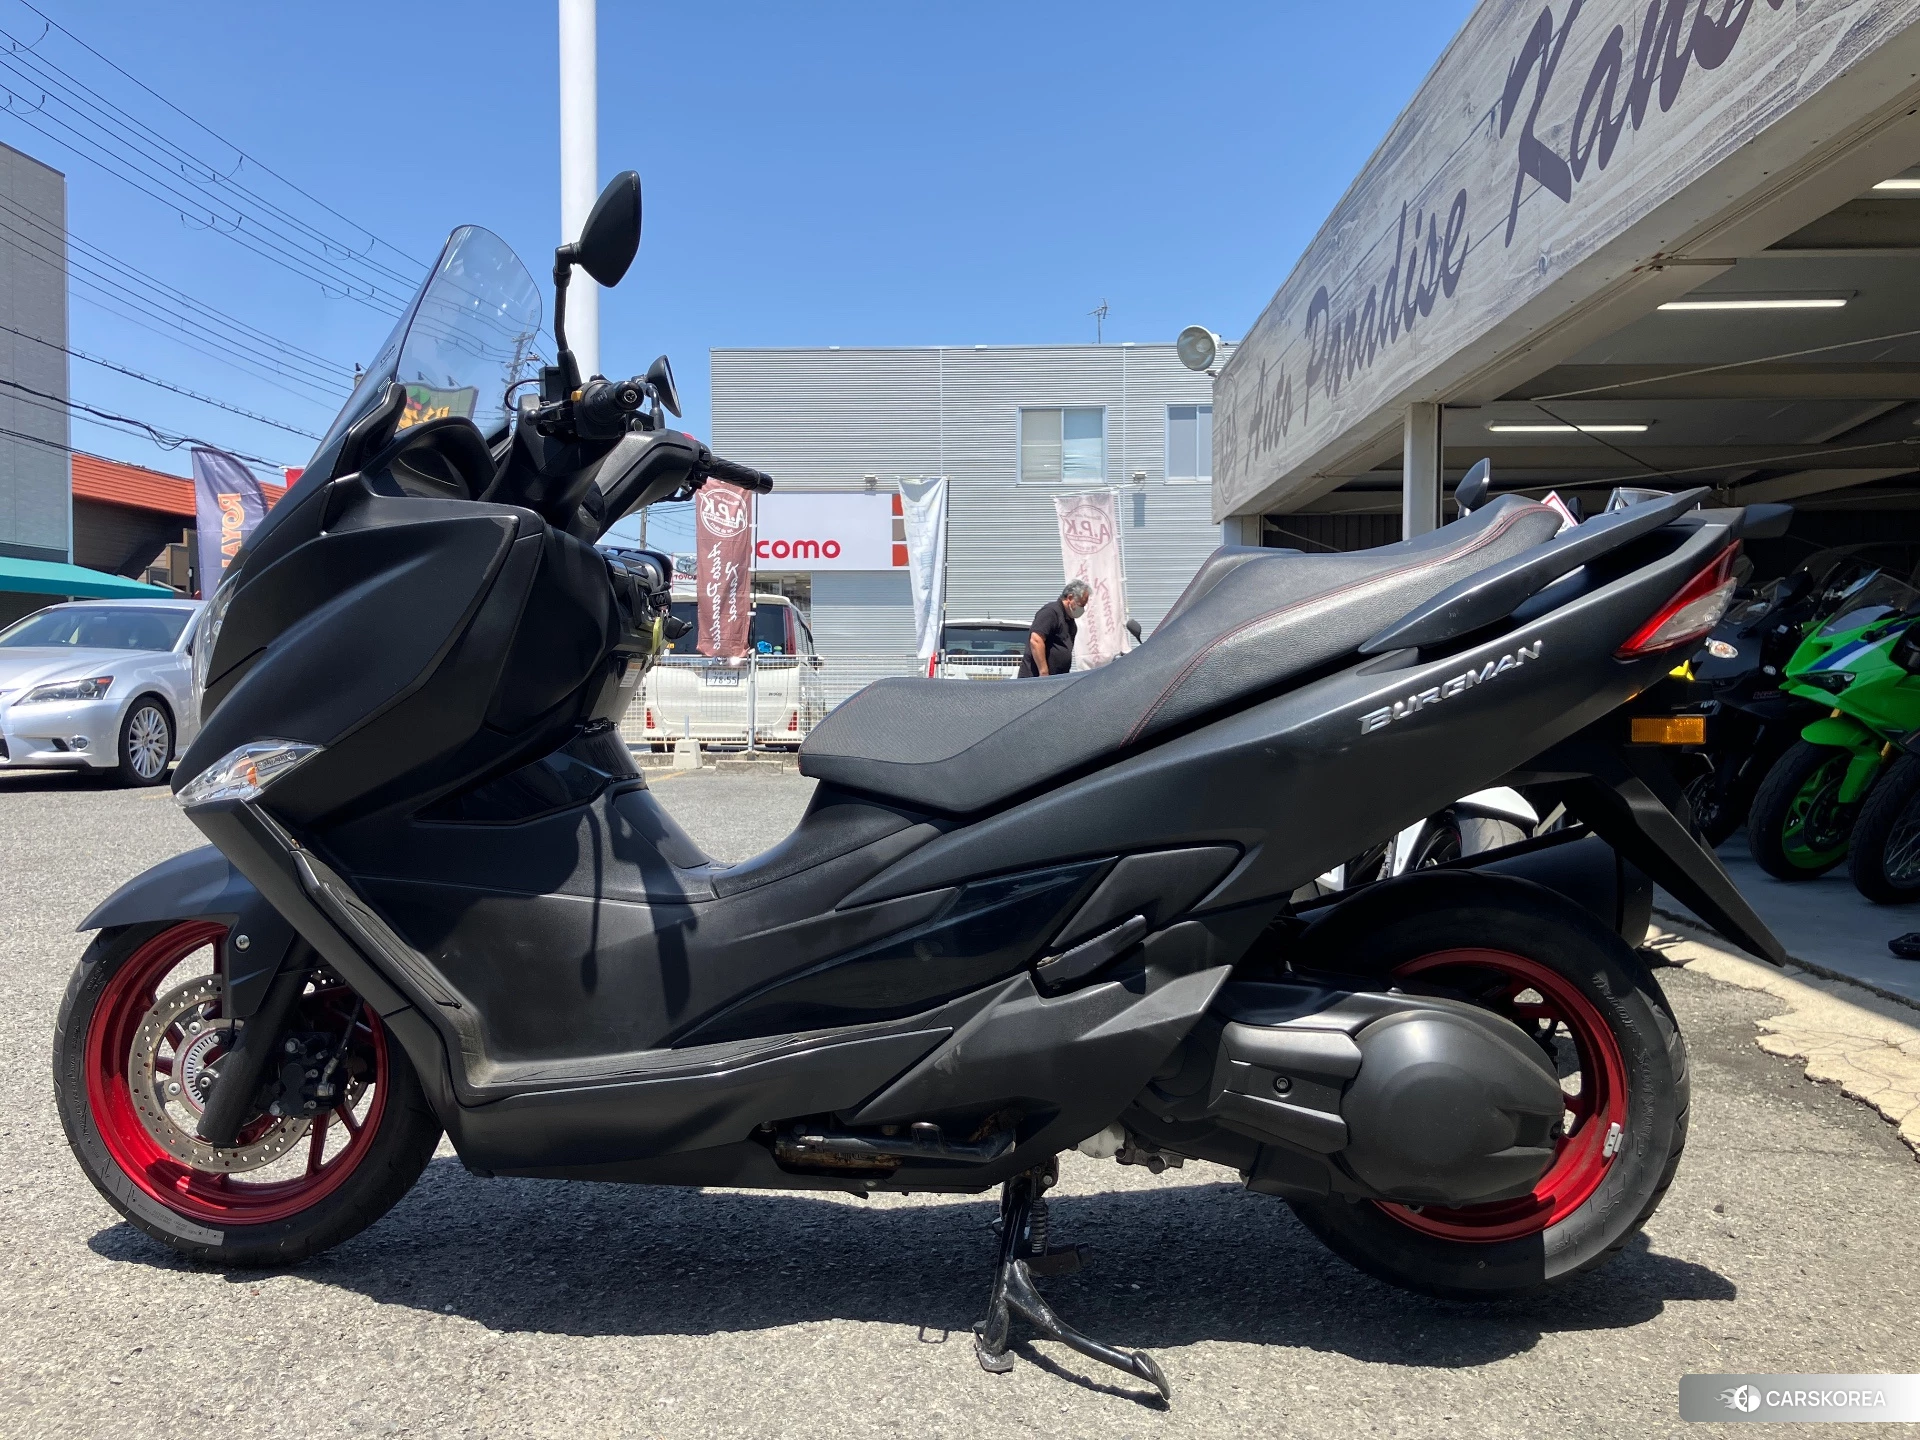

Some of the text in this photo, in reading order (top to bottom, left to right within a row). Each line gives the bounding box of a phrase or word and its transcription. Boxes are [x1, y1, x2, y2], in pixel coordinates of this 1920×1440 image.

[1245, 0, 1784, 476] Auto Paradise Kan
[750, 540, 841, 559] como
[1358, 640, 1542, 735] BURGMAN
